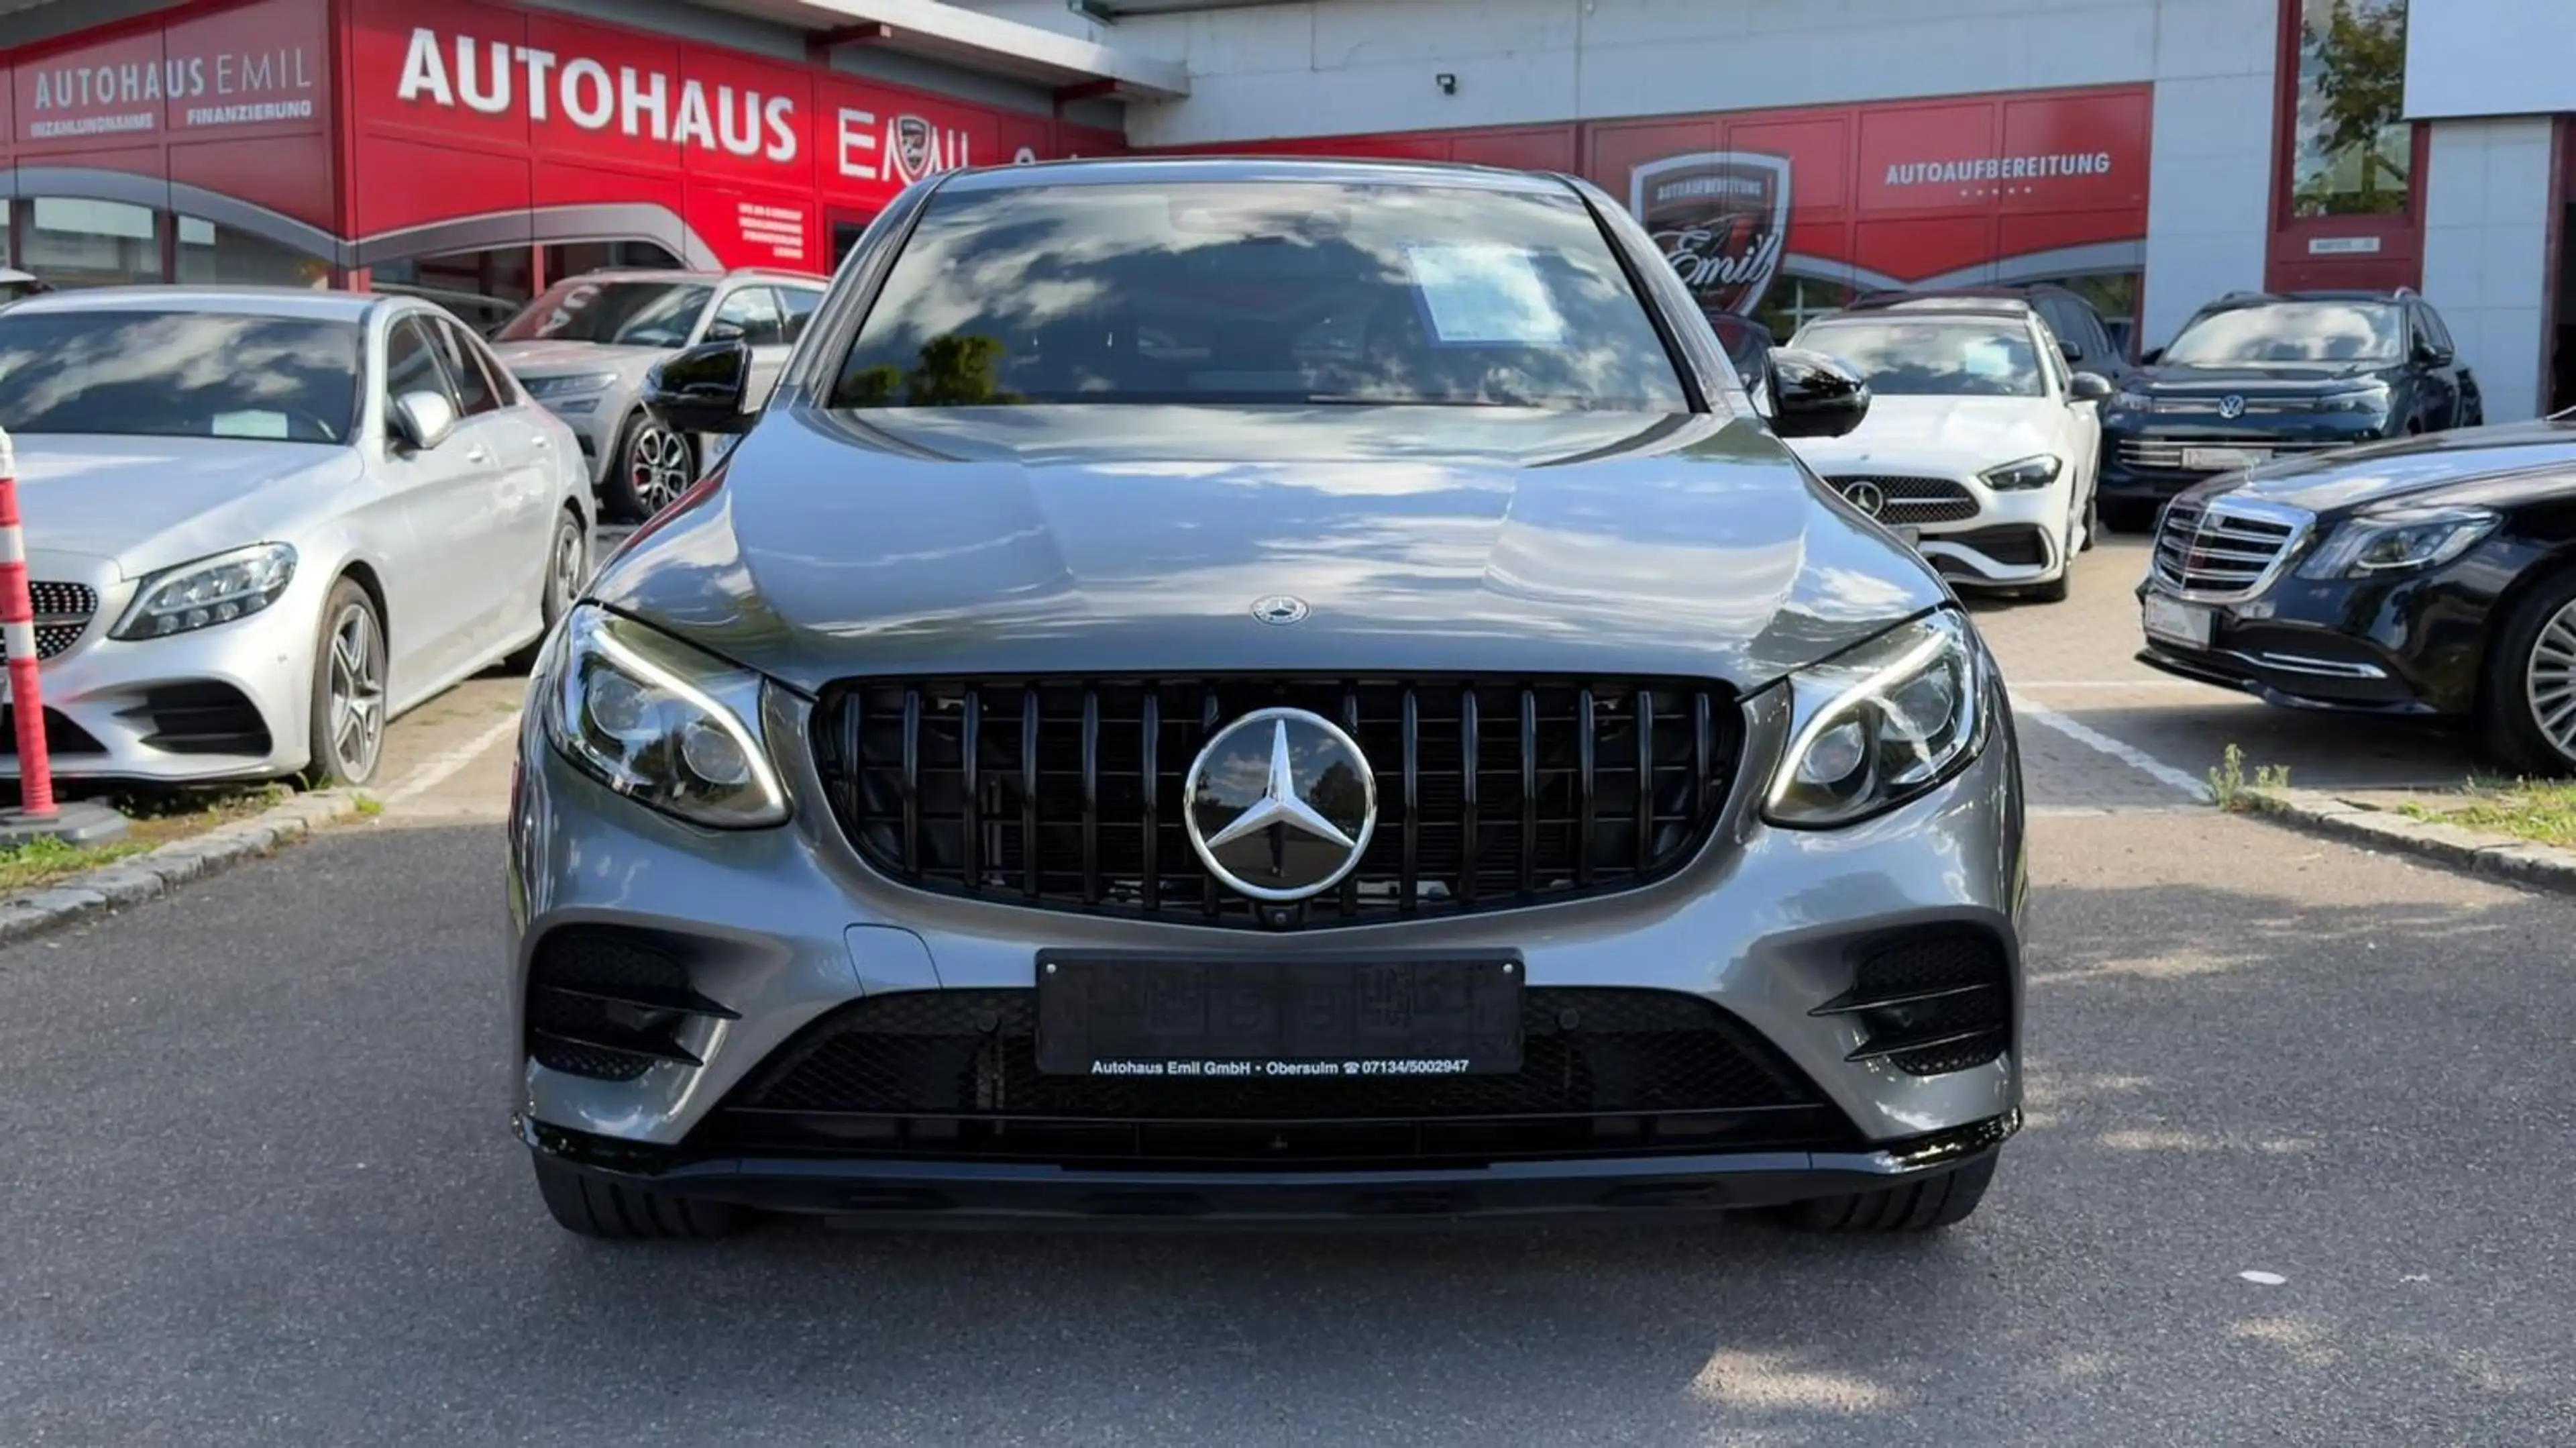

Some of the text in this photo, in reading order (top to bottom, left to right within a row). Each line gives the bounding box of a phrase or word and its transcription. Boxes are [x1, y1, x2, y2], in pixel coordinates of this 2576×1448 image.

[35, 48, 312, 109] AUTOHAUS EMIL
[398, 28, 797, 162] AUTOHAUS
[186, 99, 312, 125] FINANZIERUNG
[1885, 152, 2112, 185] AUTOAUFBEREITUNG
[1091, 1059, 1469, 1075] Autohaus Emil GmbH Obersulm 07134/5002947
